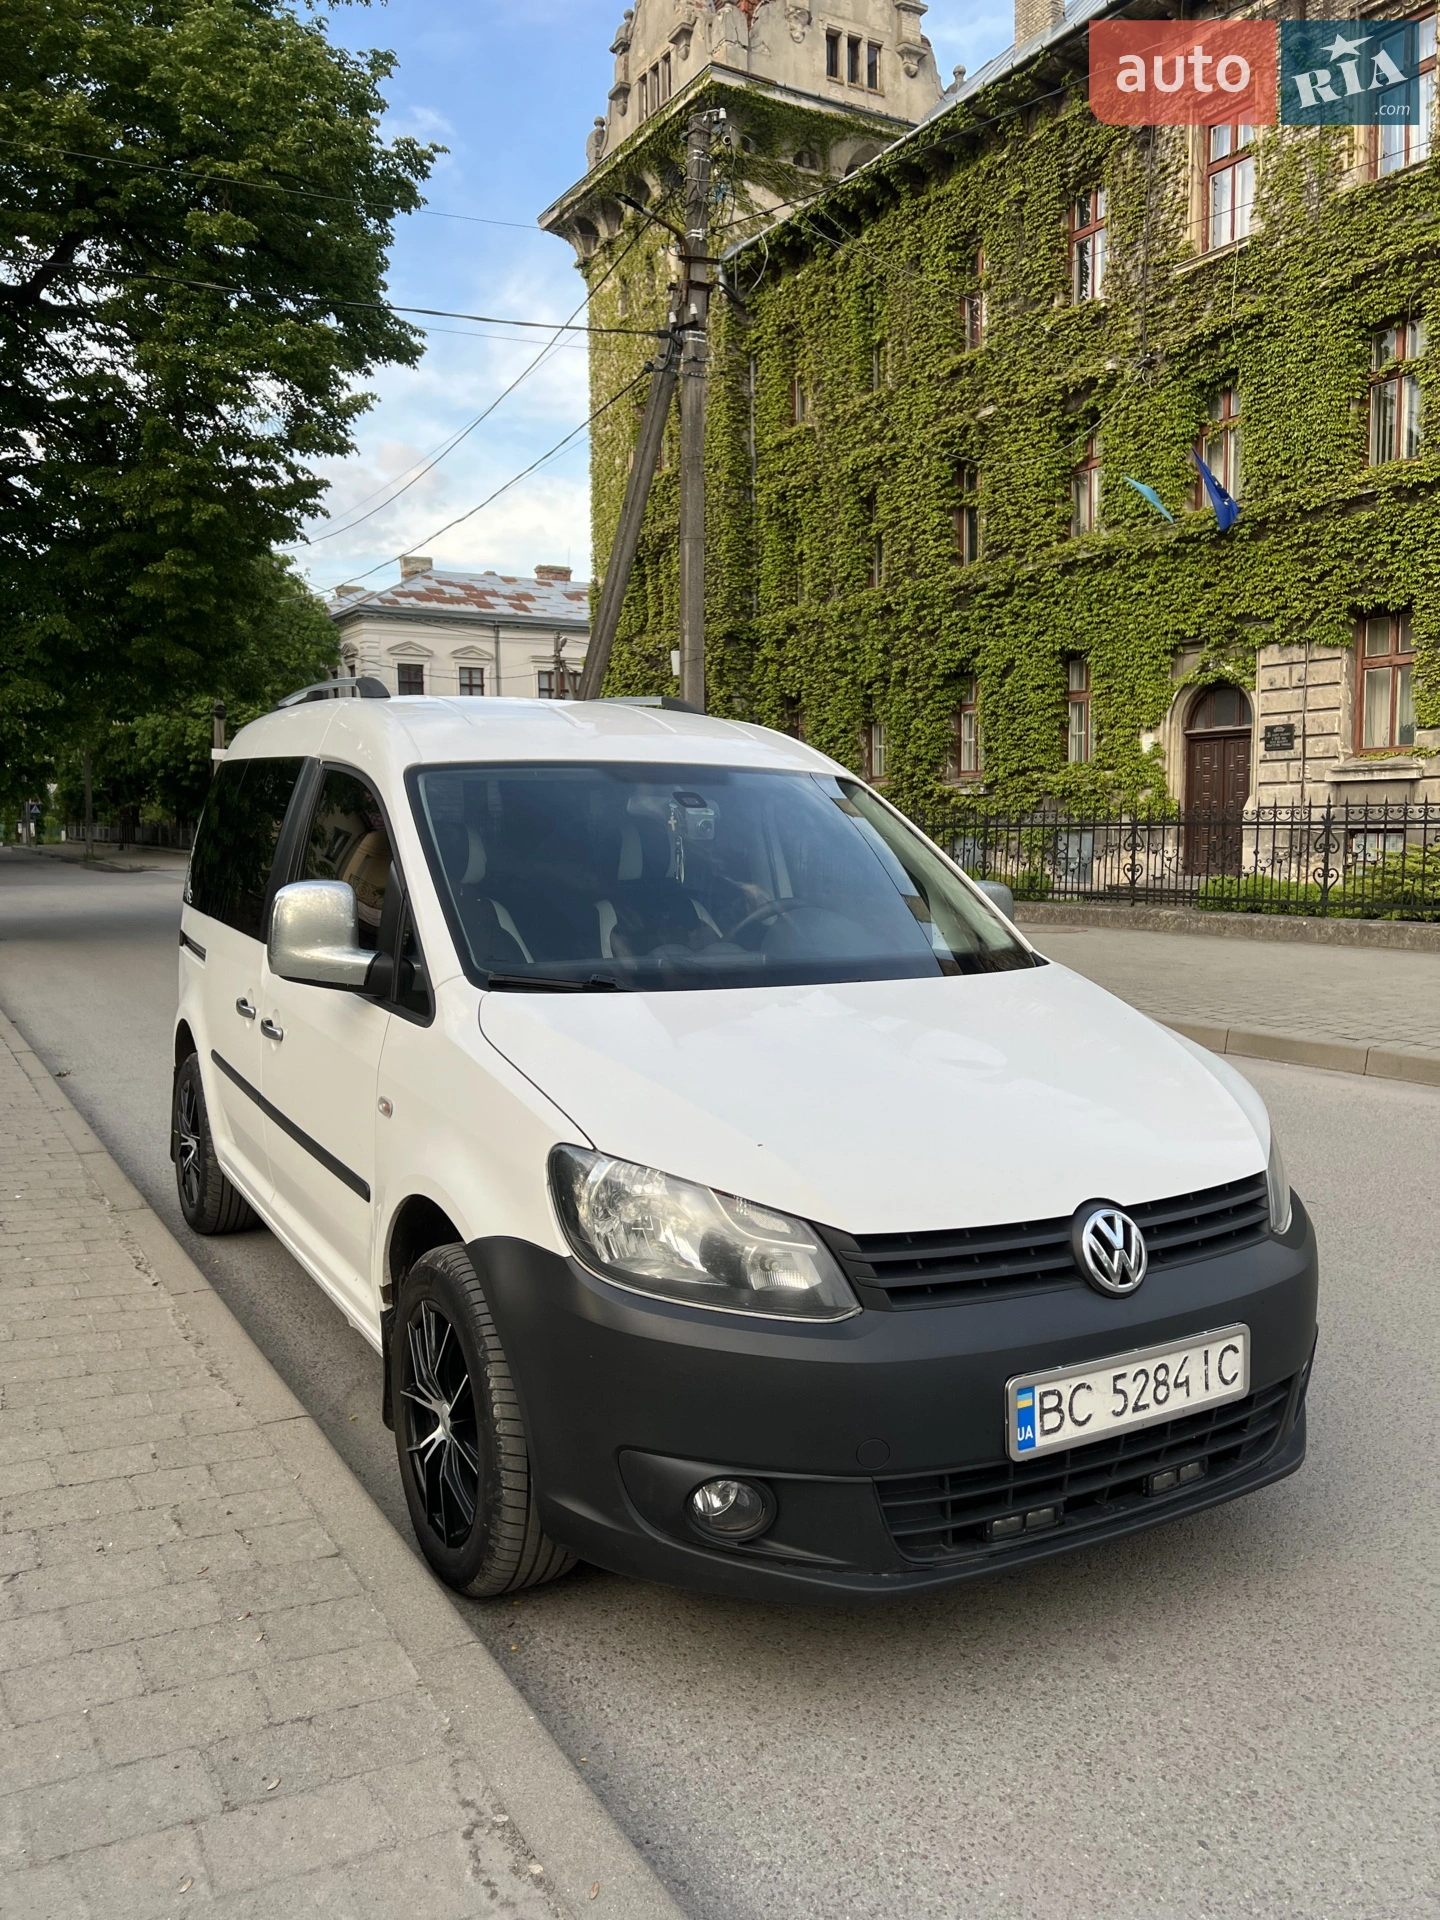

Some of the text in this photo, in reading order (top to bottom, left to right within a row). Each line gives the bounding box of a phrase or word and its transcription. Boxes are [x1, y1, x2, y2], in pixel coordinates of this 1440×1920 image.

[1039, 1343, 1240, 1436] BC 5284 IC
[1017, 1424, 1034, 1441] UA
